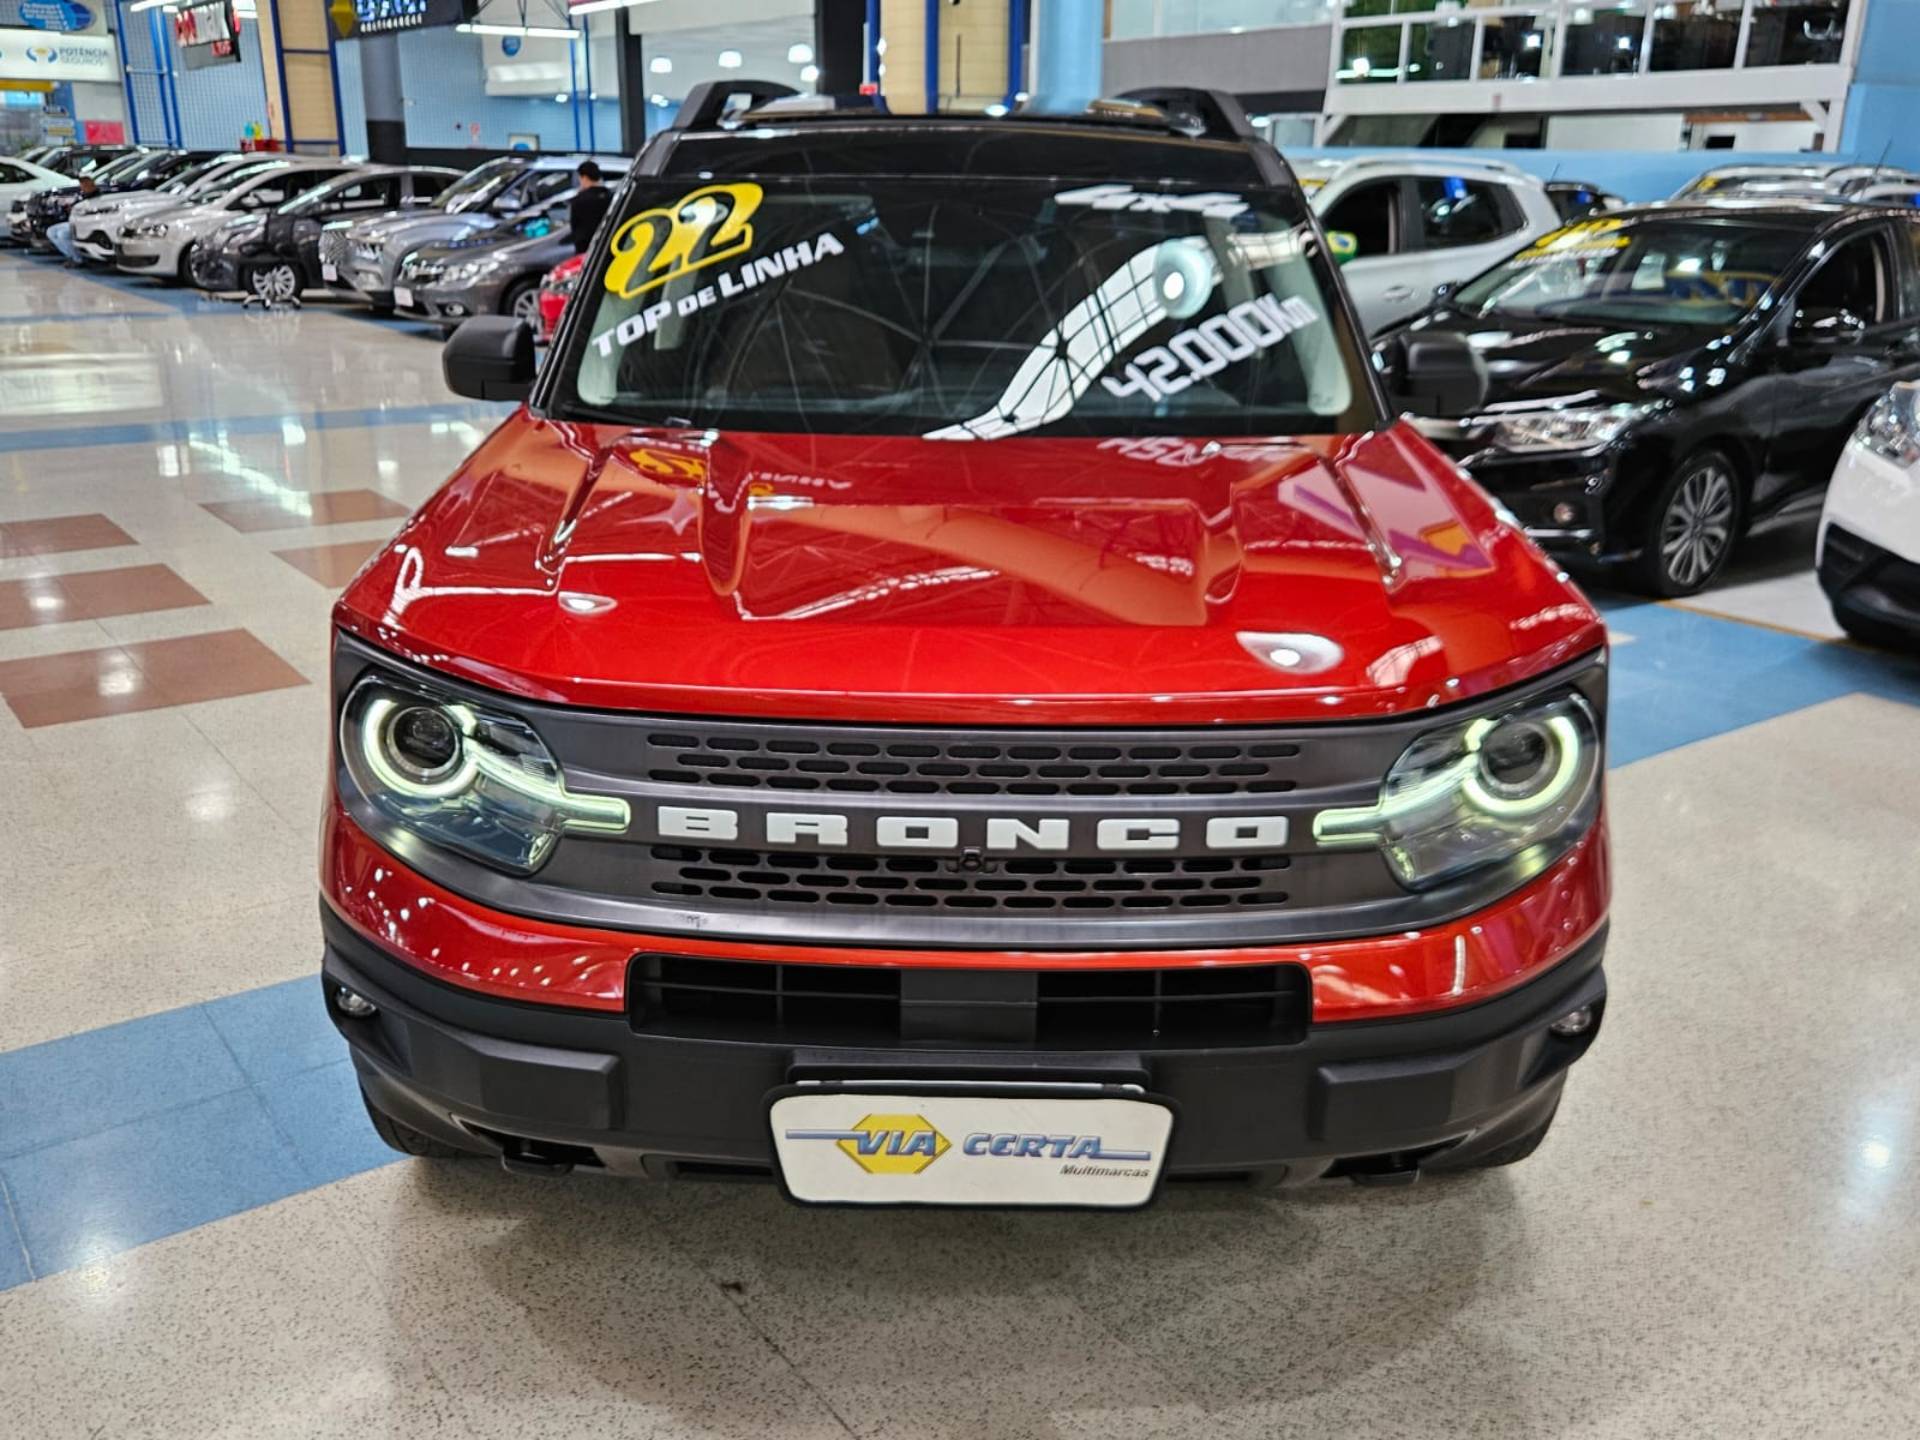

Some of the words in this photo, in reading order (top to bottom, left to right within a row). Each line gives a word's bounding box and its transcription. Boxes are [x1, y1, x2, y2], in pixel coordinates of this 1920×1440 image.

[603, 182, 764, 299] 22
[592, 300, 672, 358] TOP
[677, 286, 717, 317] DE
[717, 231, 845, 299] LINHA
[658, 805, 1289, 851] BRONCO
[856, 1129, 938, 1157] VIA
[962, 1132, 1101, 1160] CERTA
[1059, 1163, 1150, 1179] Multimarcas
